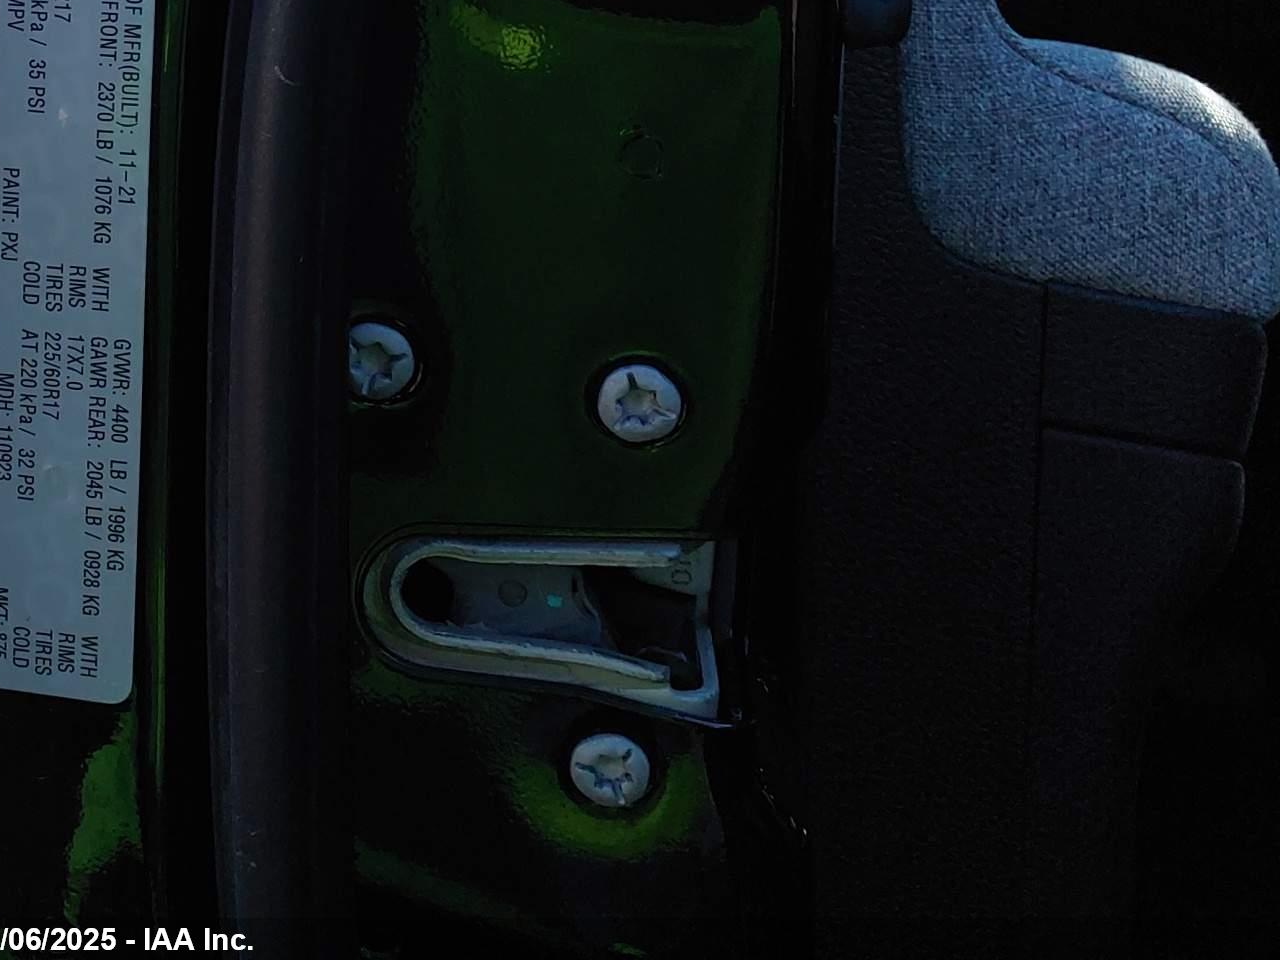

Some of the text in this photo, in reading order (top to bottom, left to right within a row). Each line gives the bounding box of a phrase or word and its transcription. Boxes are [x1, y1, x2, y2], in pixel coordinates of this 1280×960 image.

[30, 0, 48, 32] kPa
[99, 1, 119, 67] FRONT:
[29, 59, 46, 80] 35
[118, 24, 142, 134] MFR(BUILT):
[28, 86, 46, 113] PSI
[97, 82, 116, 122] 2370
[96, 130, 114, 150] LB
[94, 176, 112, 215] 1076
[118, 149, 136, 204] 11-21
[1, 168, 20, 262] PAINT: PXJ
[93, 222, 112, 244] KG
[23, 261, 41, 304] COLD
[45, 264, 64, 312] TIRES
[68, 266, 87, 308] RIMS
[91, 268, 110, 312] WITH
[21, 329, 39, 353] AT
[20, 358, 38, 388] 220
[89, 337, 108, 388] GAWR
[112, 339, 132, 395] GVWR:
[19, 394, 38, 424] kPa
[88, 396, 106, 448] REAR:
[111, 404, 129, 443] 4400
[16, 448, 35, 468] 32
[110, 460, 128, 480] LB
[17, 474, 34, 501] PSI
[86, 460, 104, 500] 2045
[34, 332, 62, 676] 225/60R17 TIRES
[58, 336, 85, 674] 17X7.0 RIMS
[85, 506, 103, 526] LB
[108, 506, 126, 543] 1996
[83, 550, 101, 588] 0928
[106, 549, 124, 571] KG
[82, 594, 100, 616] KG
[12, 626, 31, 668] COLD
[80, 636, 98, 678] WITH
